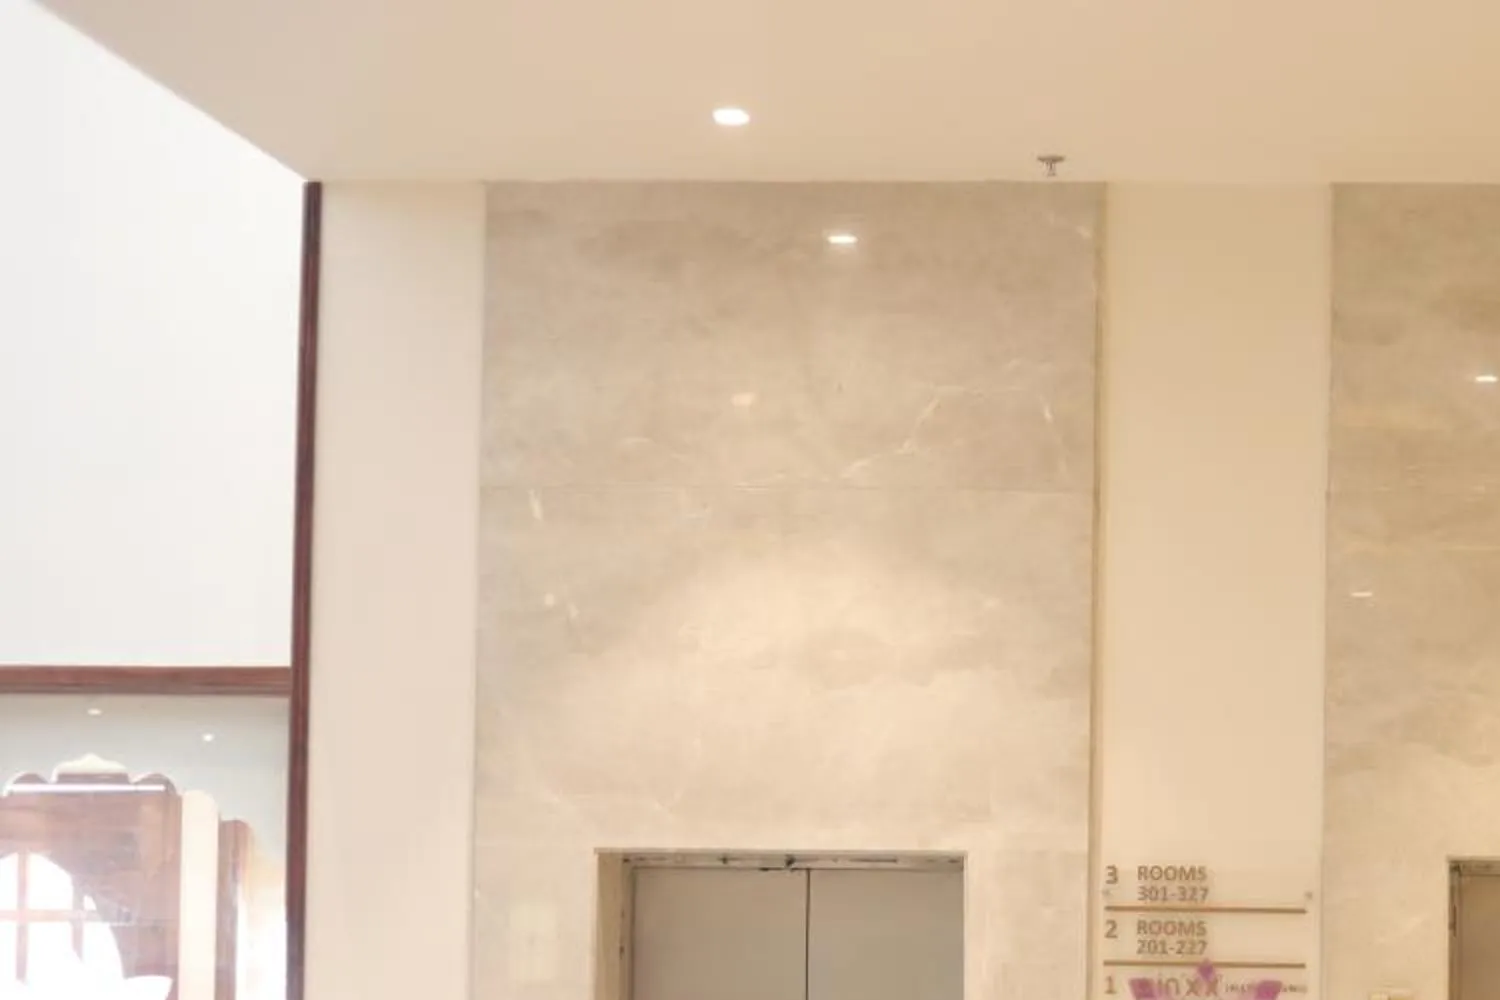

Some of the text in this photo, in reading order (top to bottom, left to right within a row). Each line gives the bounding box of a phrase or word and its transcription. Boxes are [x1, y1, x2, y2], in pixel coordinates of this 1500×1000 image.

[1105, 865, 1118, 884] 3
[1137, 865, 1208, 881] ROOMS
[1137, 886, 1209, 902] 301-327
[1105, 919, 1118, 938] 2
[1136, 920, 1208, 936] ROOMS
[1136, 939, 1208, 955] 201-227
[1105, 976, 1117, 994] 1
